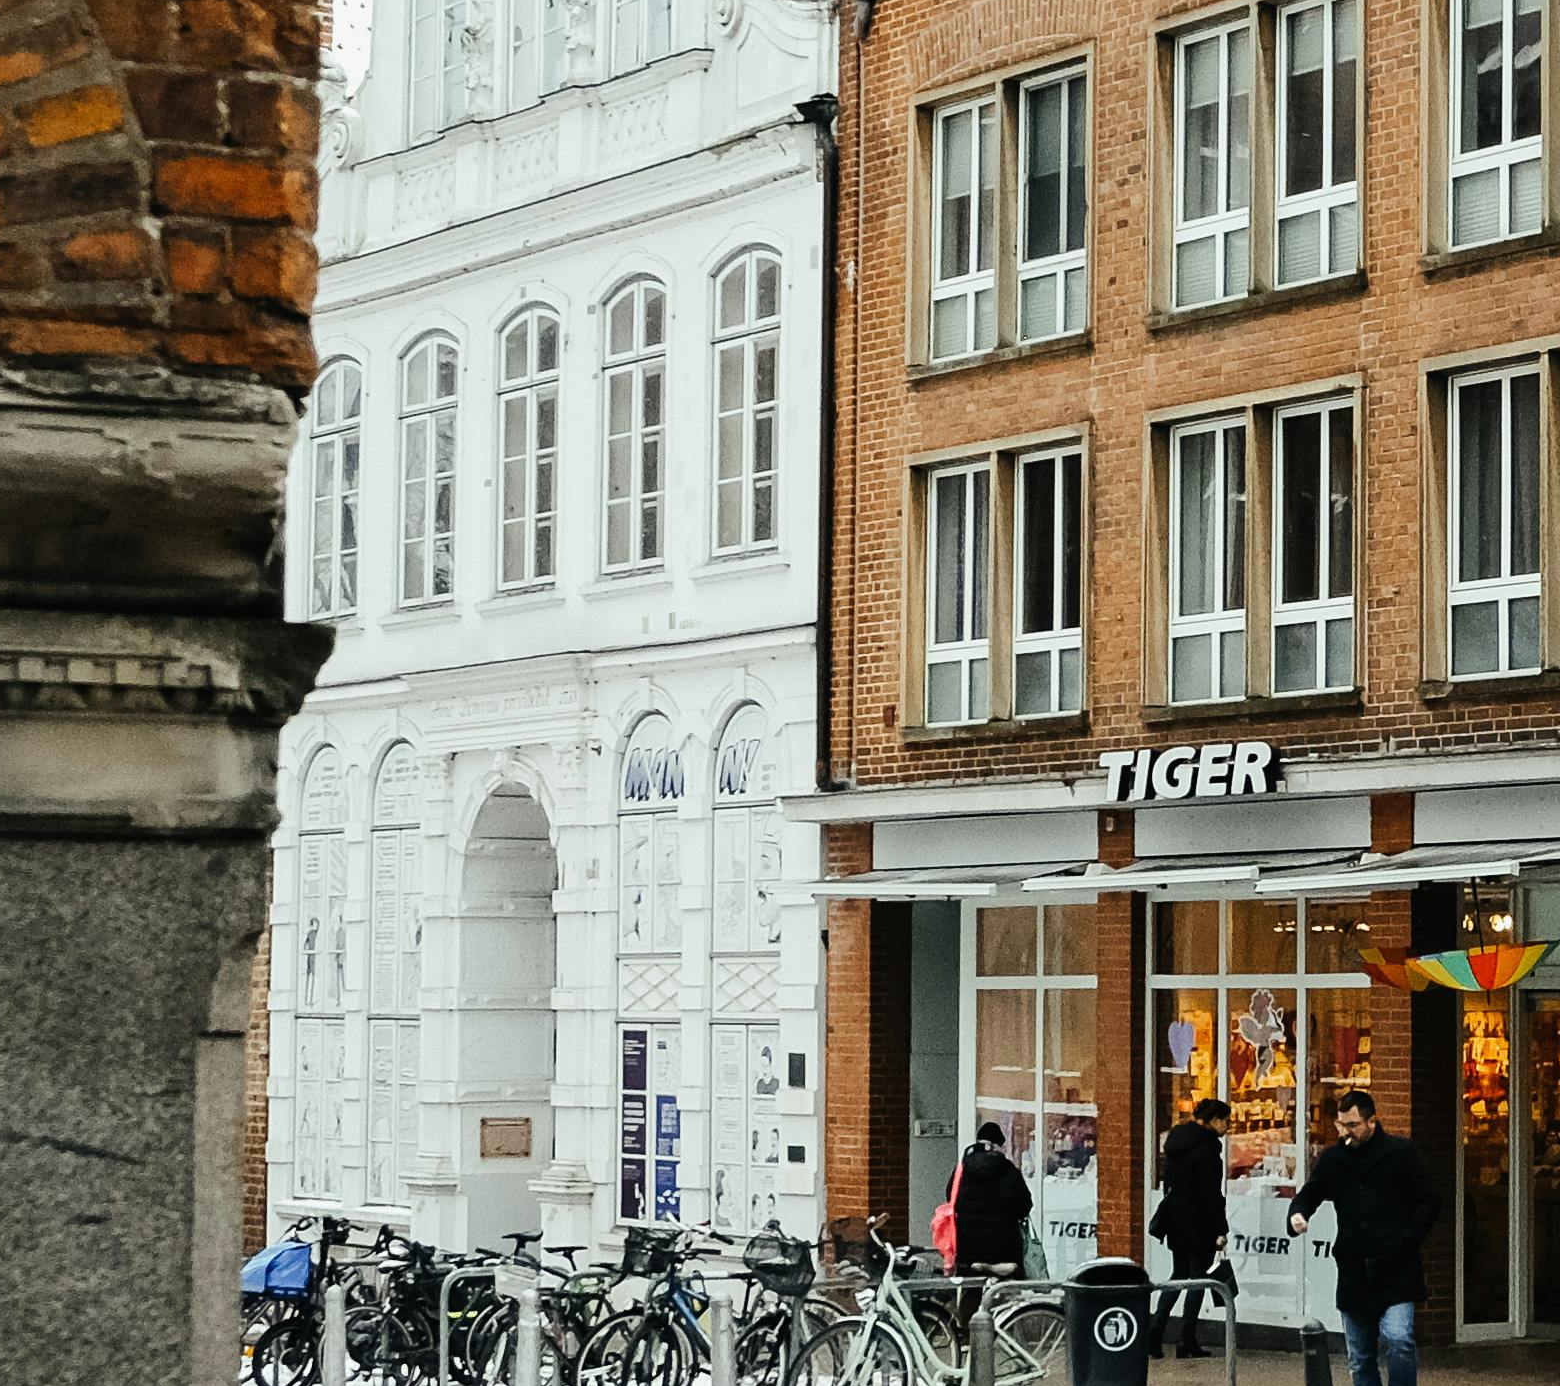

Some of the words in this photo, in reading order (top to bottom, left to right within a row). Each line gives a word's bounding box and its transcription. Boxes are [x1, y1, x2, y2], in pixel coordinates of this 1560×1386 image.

[1098, 740, 1272, 802] TIGER
[1233, 1233, 1290, 1256] TIGER
[1312, 1240, 1332, 1259] TI
